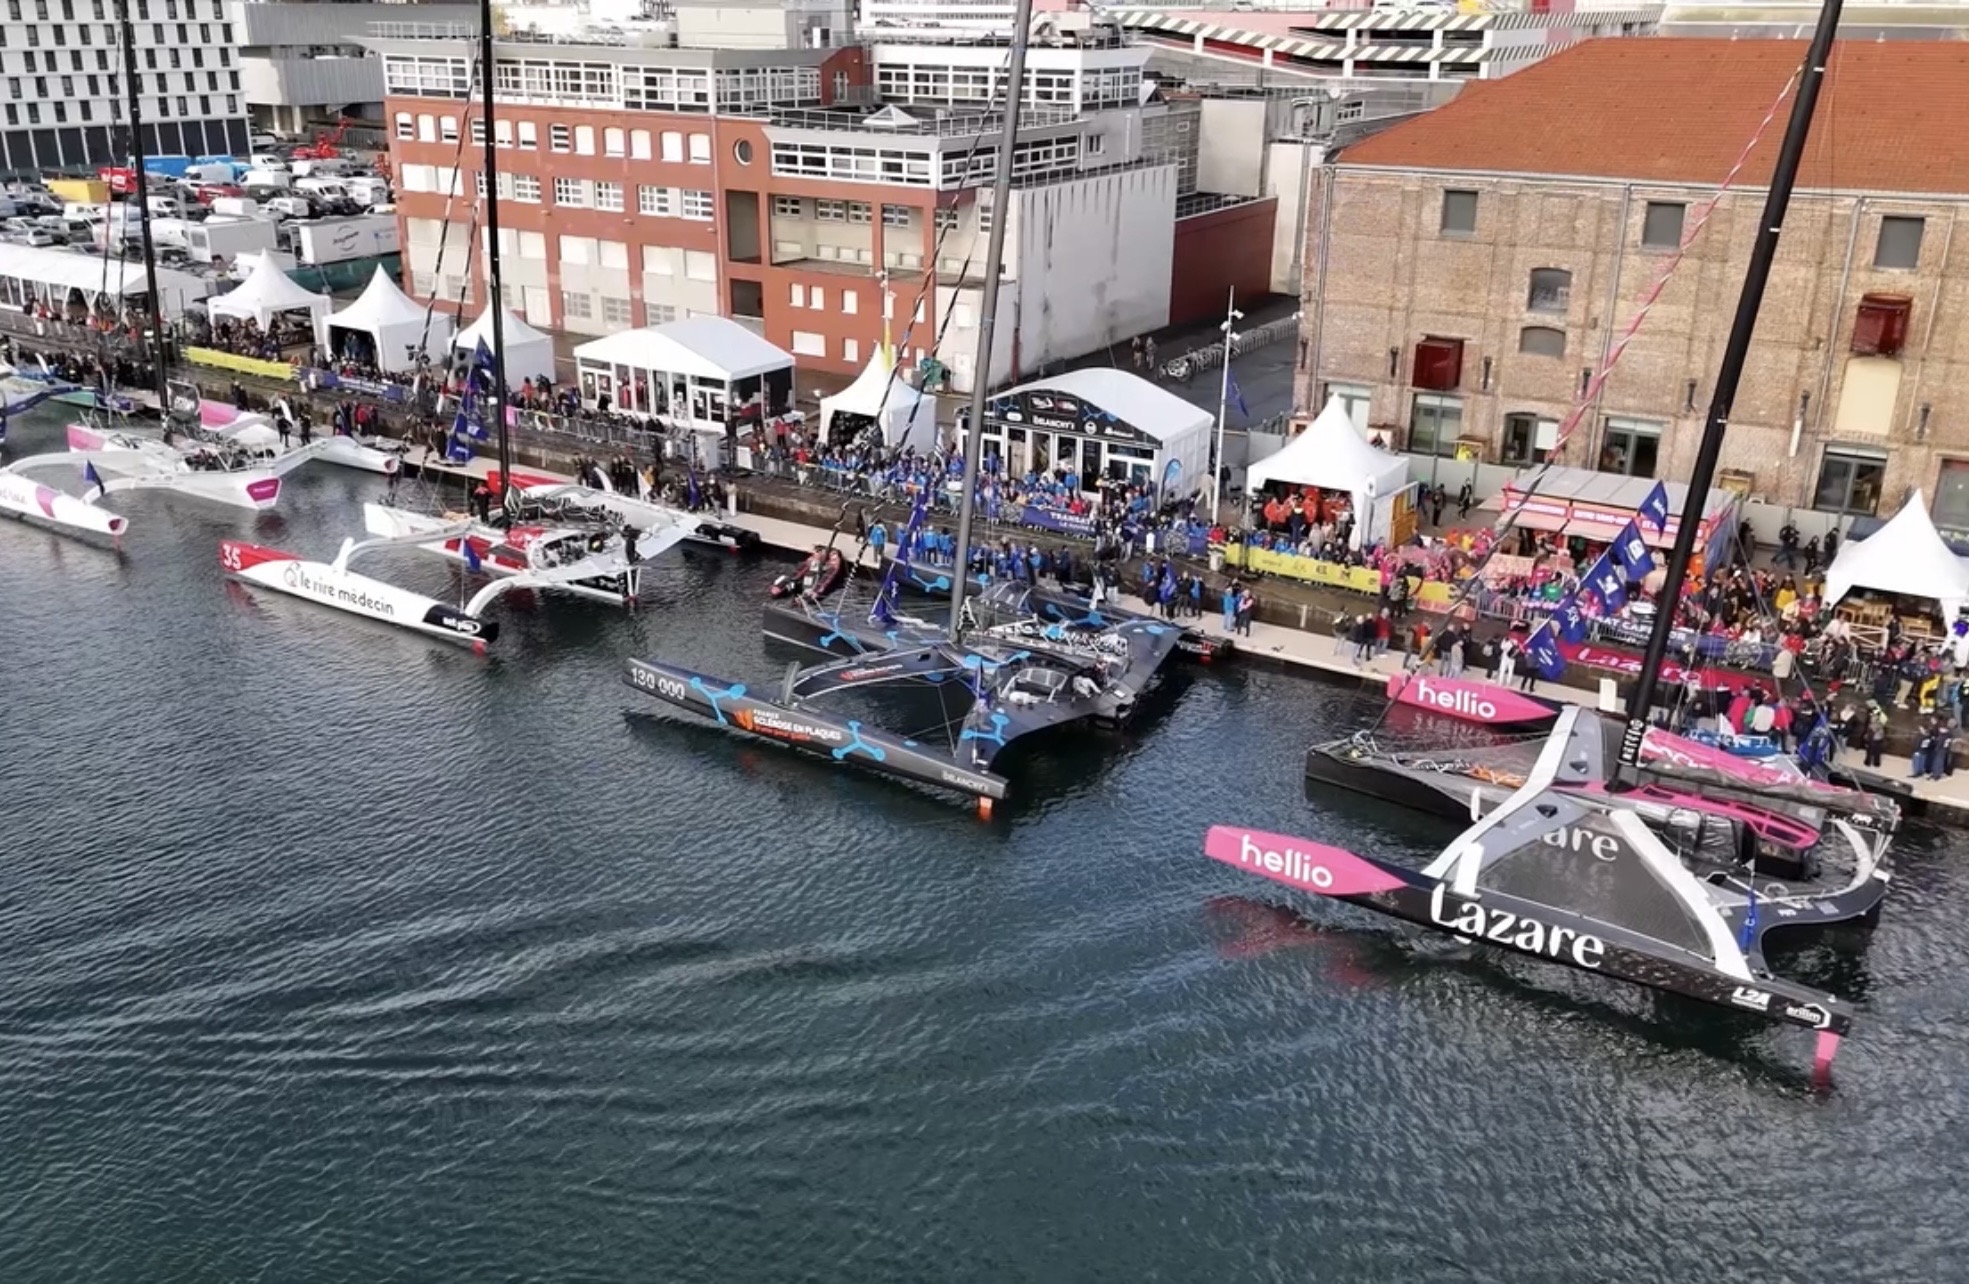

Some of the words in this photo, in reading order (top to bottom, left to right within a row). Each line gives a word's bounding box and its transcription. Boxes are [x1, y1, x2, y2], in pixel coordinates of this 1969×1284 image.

[222, 542, 242, 570] 35
[299, 571, 311, 590] le
[313, 575, 335, 598] rire
[338, 587, 395, 616] médecin
[631, 667, 655, 689] 130
[658, 677, 686, 700] 000
[1419, 678, 1497, 718] hellio
[805, 725, 842, 741] PLAQUES
[1241, 833, 1334, 888] hellio
[1430, 882, 1605, 969] Lazare
